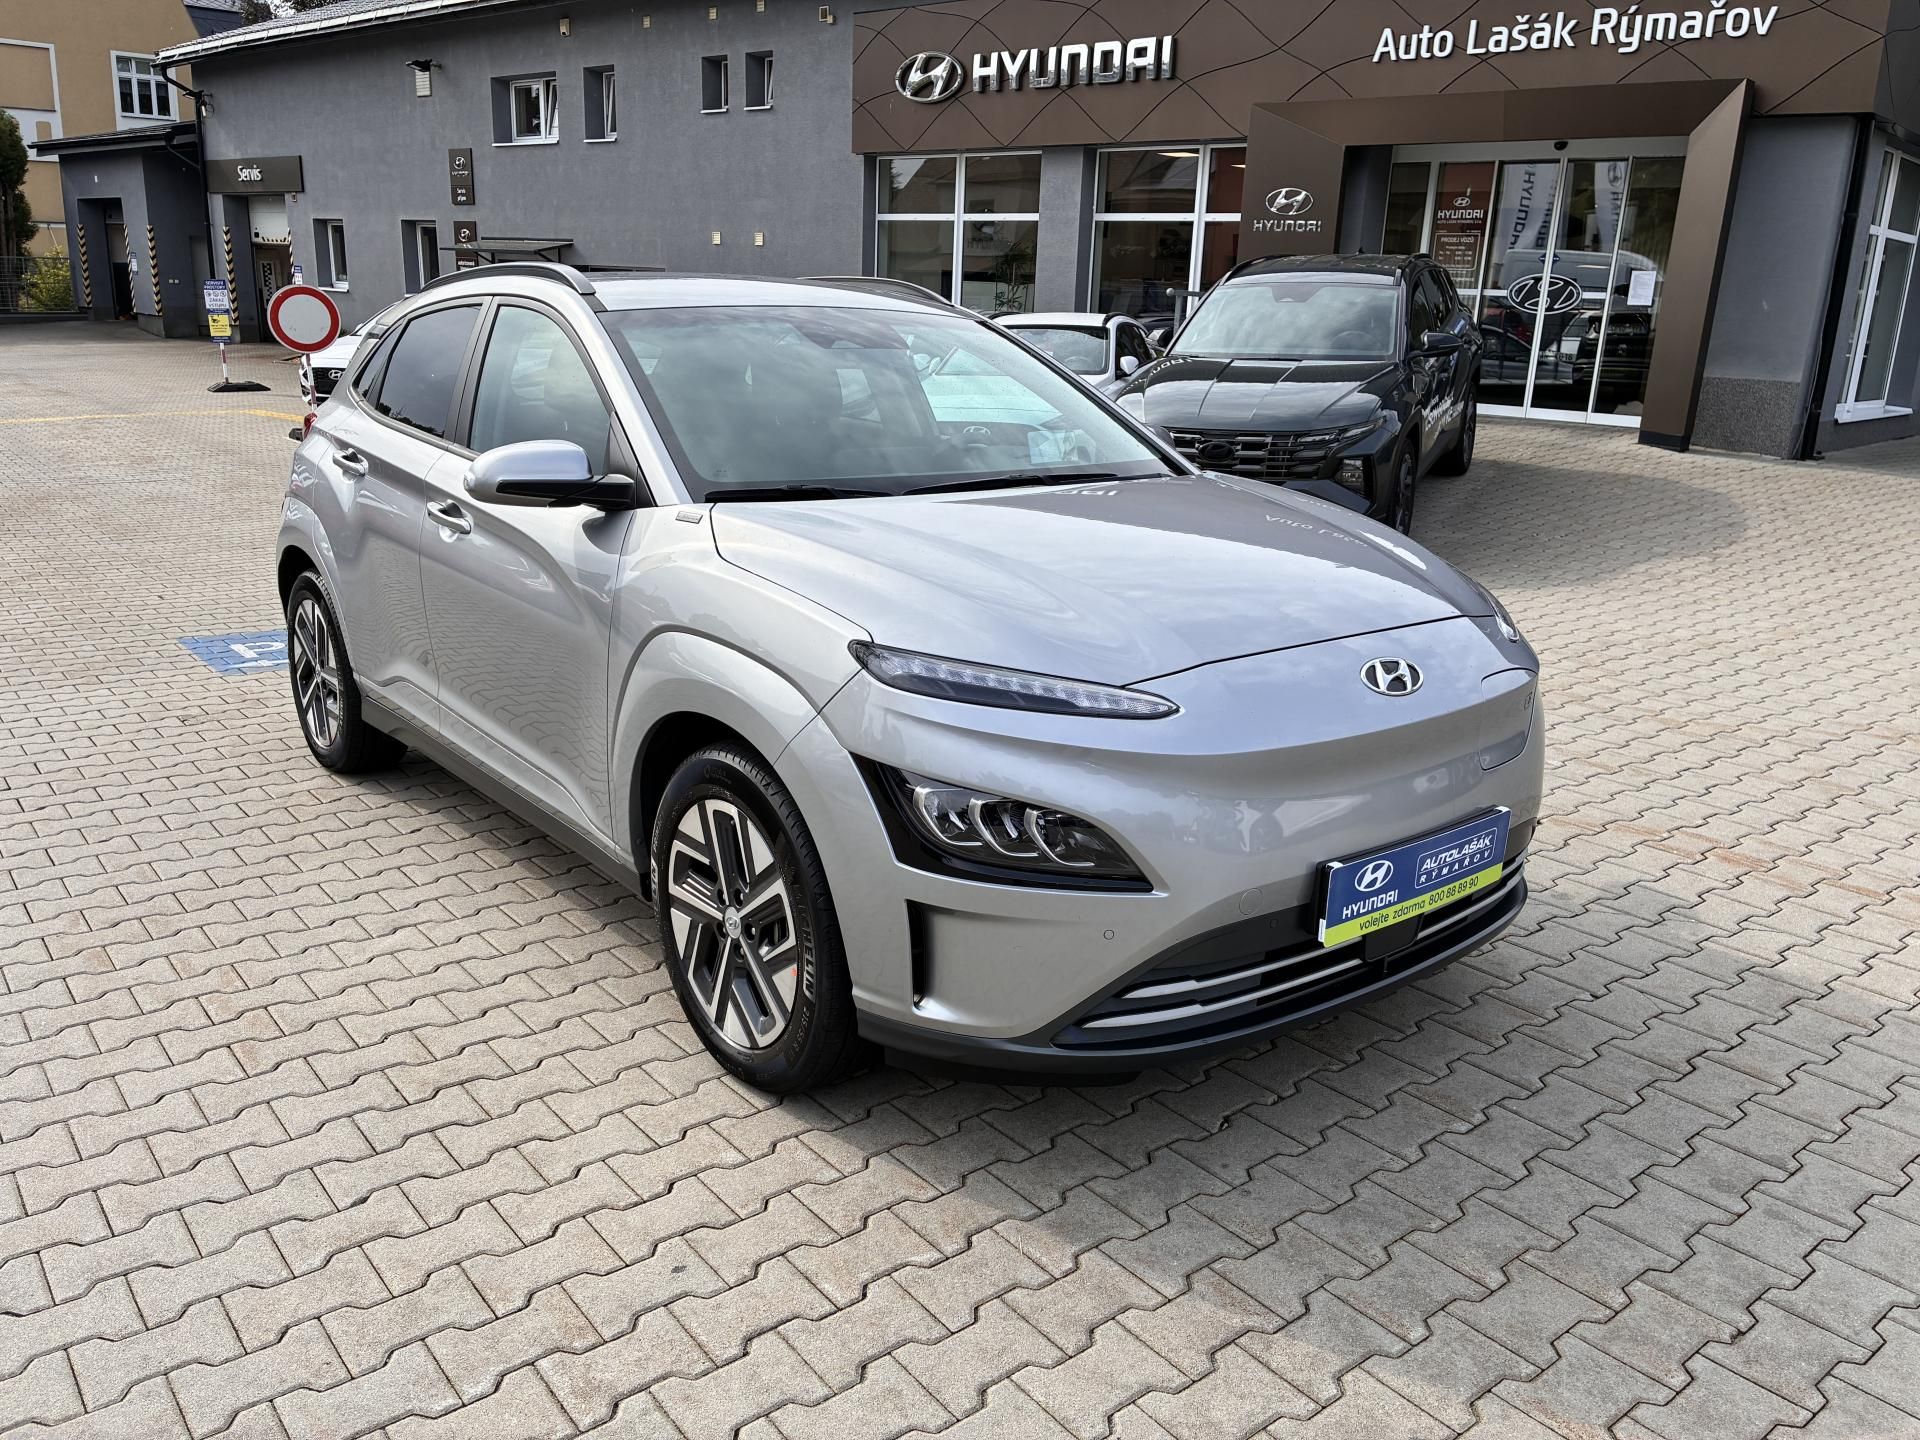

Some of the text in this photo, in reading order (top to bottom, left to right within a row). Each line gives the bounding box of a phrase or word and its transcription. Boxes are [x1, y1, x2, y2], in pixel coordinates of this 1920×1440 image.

[1371, 0, 1779, 63] Auto Lašák Rýmařov
[972, 35, 1177, 93] HYUNDAI
[237, 164, 262, 182] Servis
[1253, 219, 1322, 232] HYUNDAI
[1437, 209, 1484, 219] HYUNDAI
[1419, 849, 1490, 884] RÝMAŘOV
[1420, 834, 1493, 871] AUTOLAŠÁK
[1342, 889, 1399, 920] HYUNDAI
[1359, 875, 1479, 931] volejte zdarma 800 88 89 90
